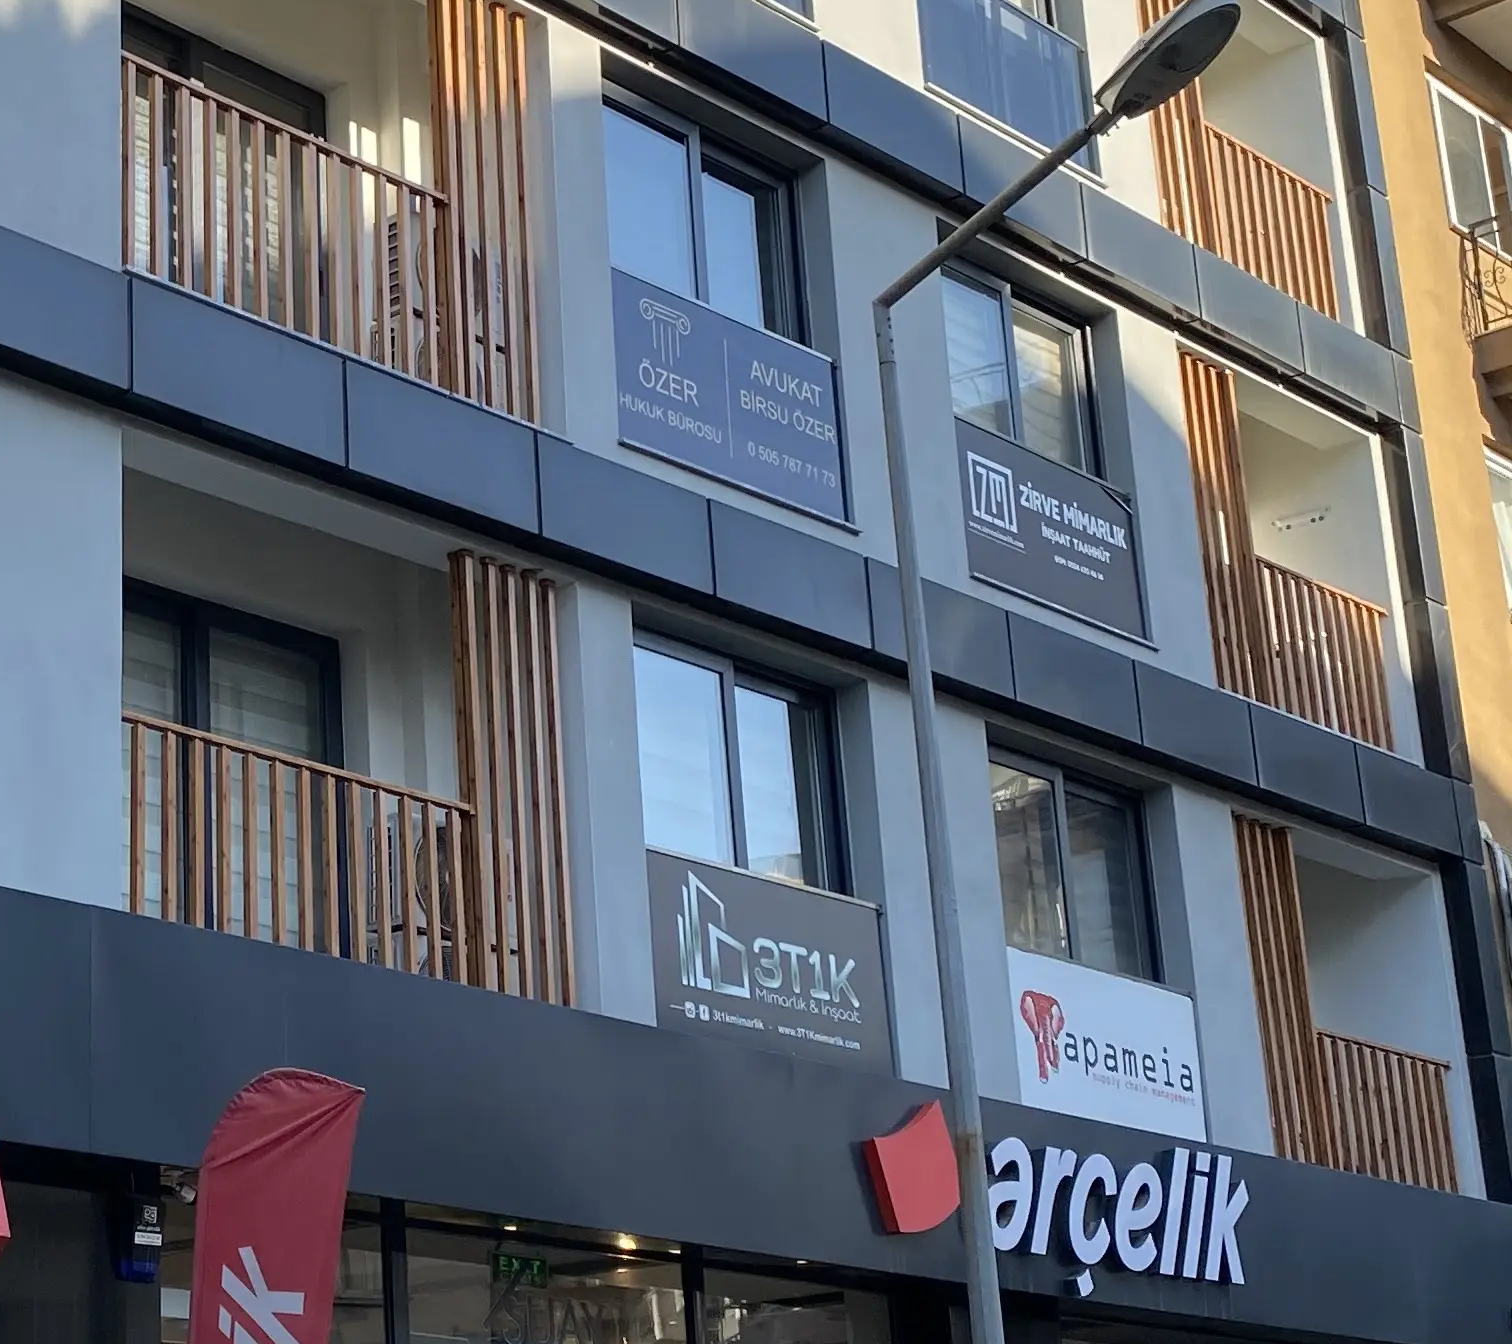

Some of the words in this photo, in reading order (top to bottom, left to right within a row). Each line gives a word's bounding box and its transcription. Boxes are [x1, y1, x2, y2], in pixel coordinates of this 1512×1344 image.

[639, 358, 699, 407] ÖZER
[750, 360, 822, 407] AVUKAT
[619, 391, 665, 421] HUKUK
[668, 410, 722, 444] BÜROSU
[740, 389, 788, 425] BİRSU
[793, 410, 836, 445] ÖZER
[748, 441, 755, 457] 0
[758, 445, 779, 467] 505
[782, 455, 802, 474] 787
[806, 463, 818, 479] 71
[822, 469, 836, 488] 73
[1018, 482, 1061, 521] ZİRVE
[1063, 502, 1128, 550] MİMARLIK
[1041, 522, 1071, 545] İNŞAAT
[753, 937, 860, 1008] 3T1K
[809, 999, 819, 1013] &
[988, 1136, 1249, 1297] arçelik
[499, 1256, 541, 1274] EXT
